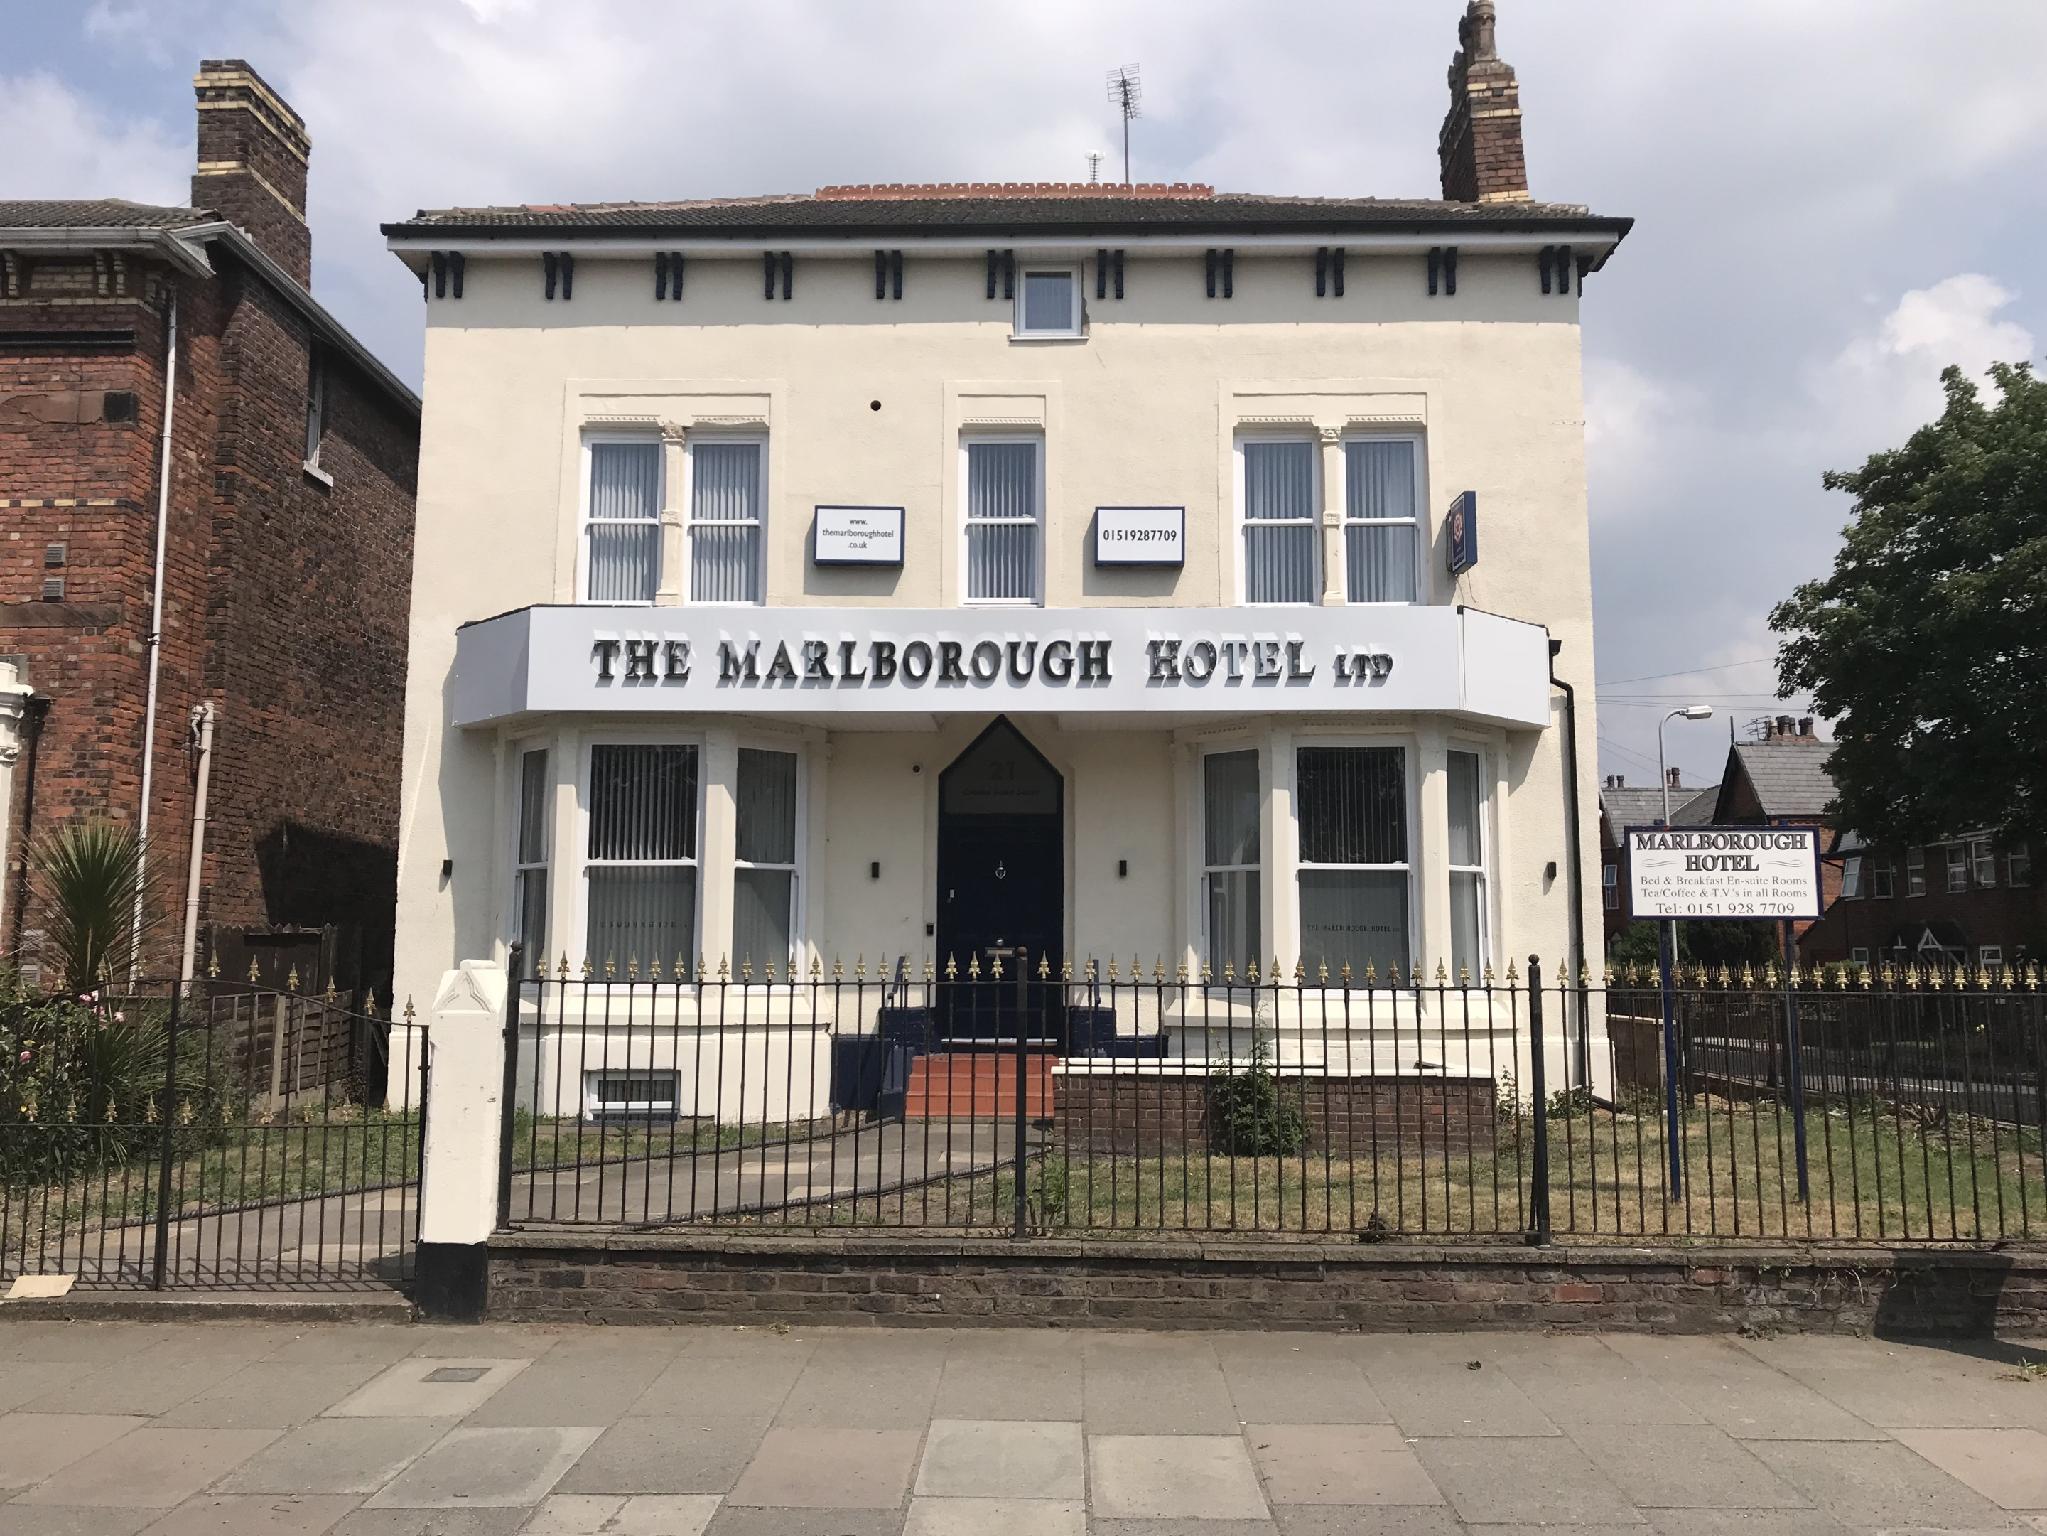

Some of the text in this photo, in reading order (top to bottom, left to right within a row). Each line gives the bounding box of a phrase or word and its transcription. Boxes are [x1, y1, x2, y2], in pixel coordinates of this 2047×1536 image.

[822, 527, 894, 539] themarlboroughhotel
[1102, 529, 1177, 541] 01519287709
[848, 541, 868, 549] .co.uk
[593, 639, 1394, 682] THE MARLBOROUGH HOTEL LTD
[1636, 833, 1808, 850] MARLBOROUGH
[1685, 854, 1760, 872] HOTEL
[1640, 875, 1808, 885] Bed & Breakfast En-suite Rooms
[1640, 888, 1696, 898] Tea/Coffee
[1699, 889, 1709, 898] &
[1743, 888, 1752, 897] in
[1755, 888, 1769, 897] all
[1772, 888, 1808, 898] Rooms
[1655, 903, 1795, 914] Tel: 0151 928 7709
